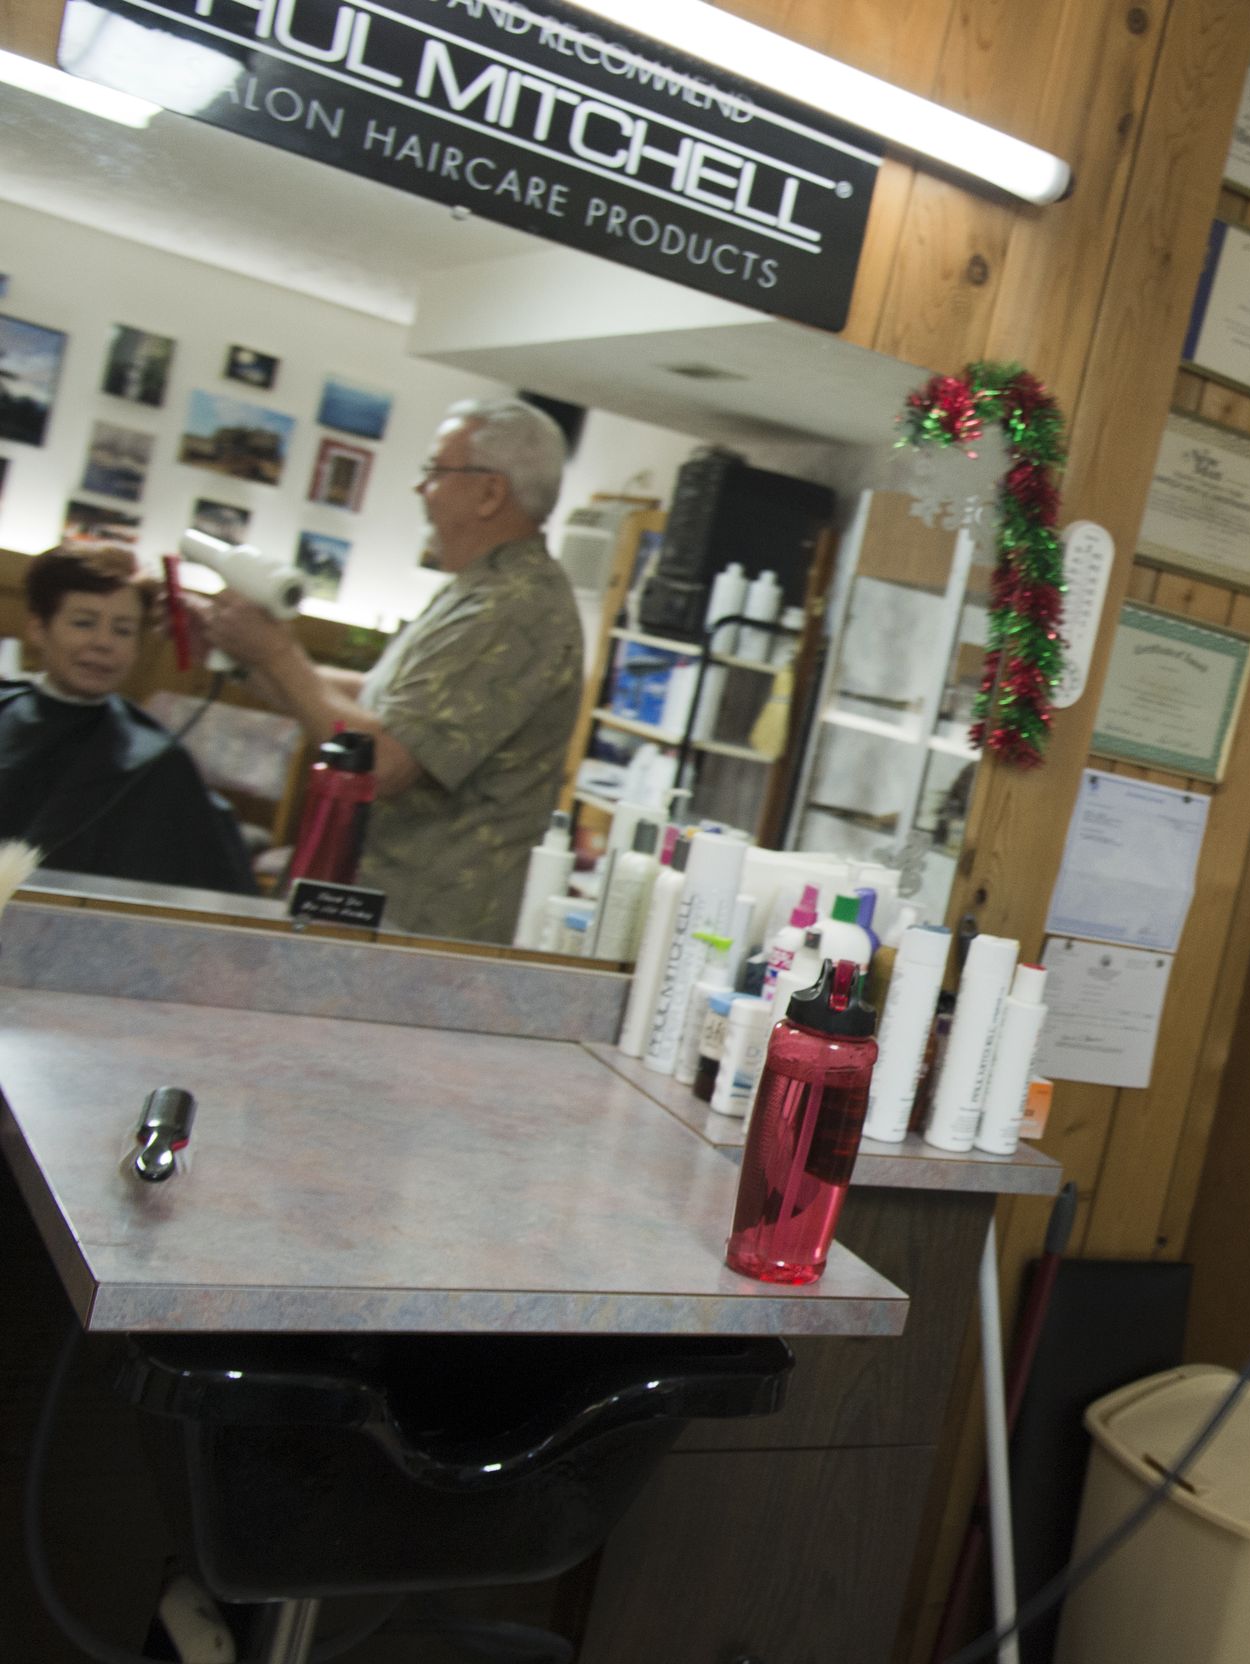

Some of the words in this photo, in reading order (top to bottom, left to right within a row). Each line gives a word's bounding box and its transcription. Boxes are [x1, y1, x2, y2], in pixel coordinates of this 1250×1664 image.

[538, 17, 755, 124] RECOMMEND
[224, 77, 344, 138] LON
[363, 119, 570, 217] HAIRCARE
[585, 198, 779, 288] PRODUCTS
